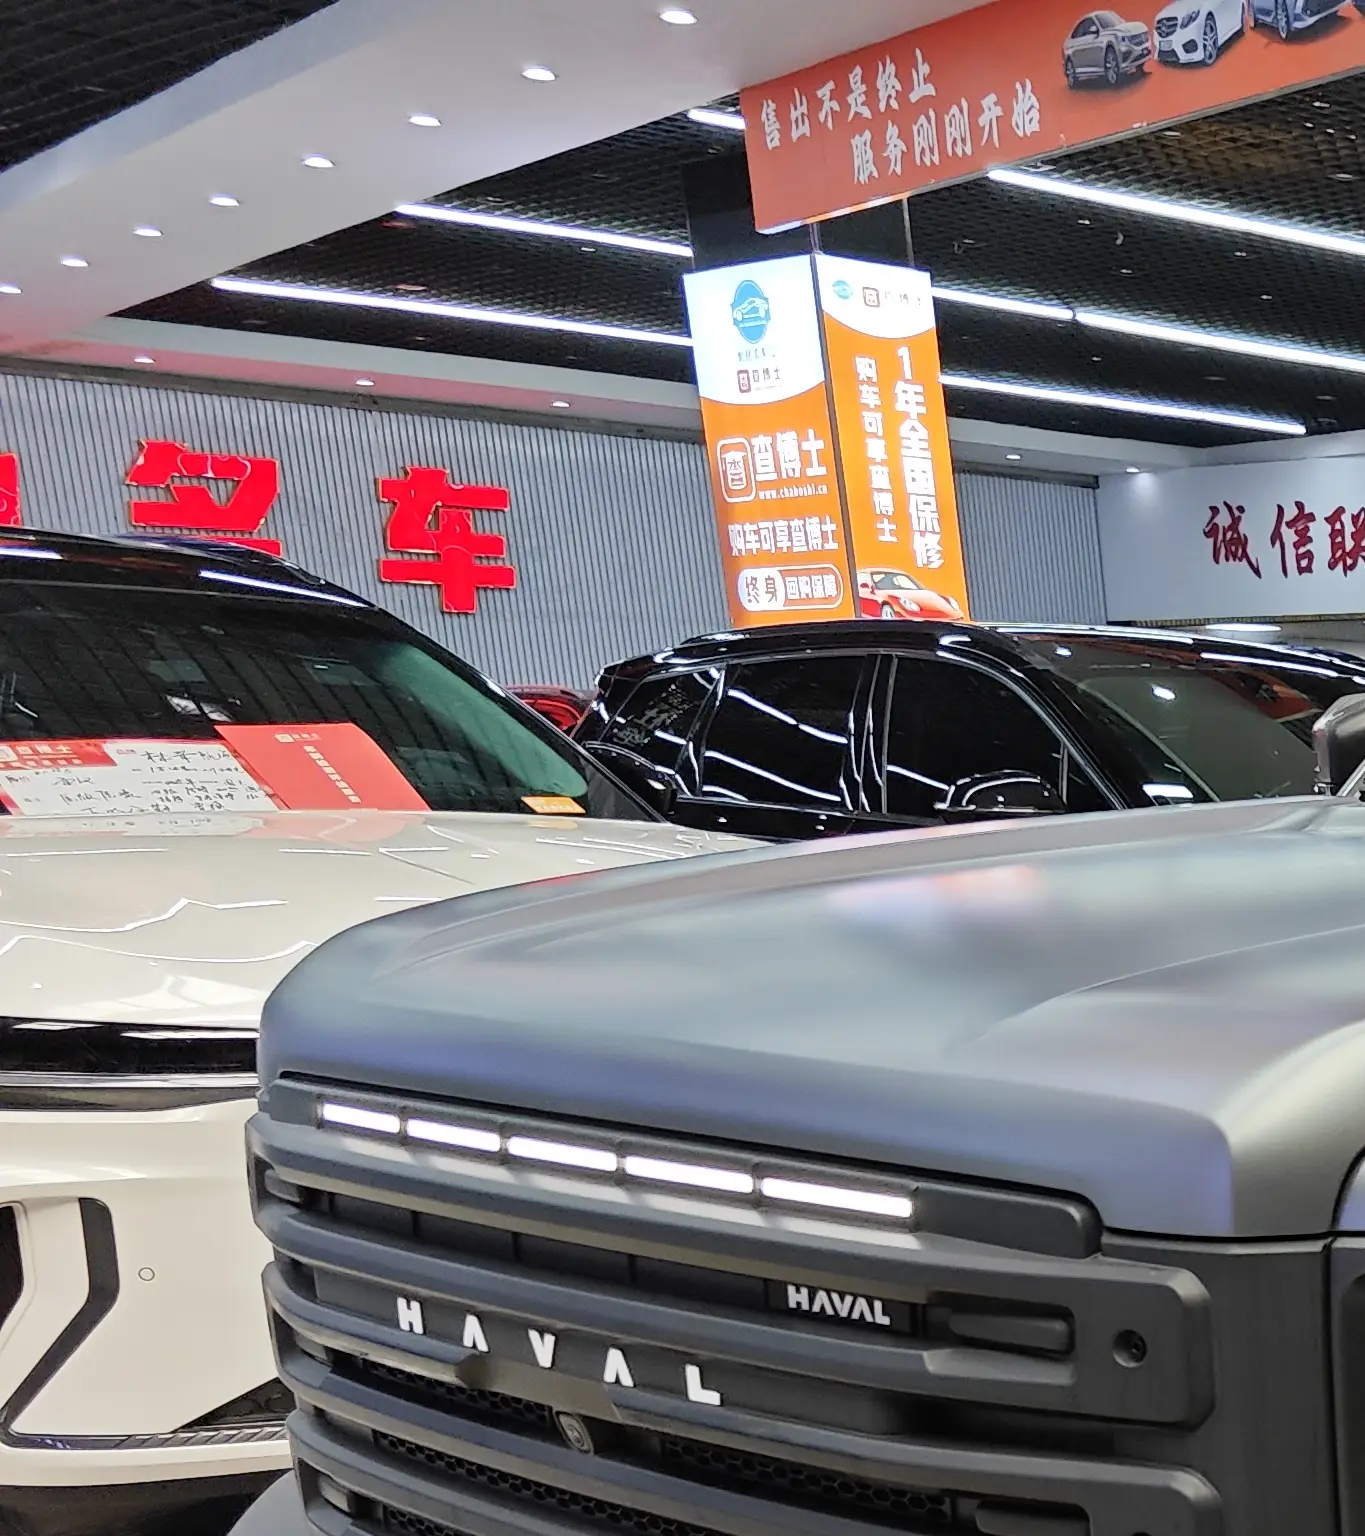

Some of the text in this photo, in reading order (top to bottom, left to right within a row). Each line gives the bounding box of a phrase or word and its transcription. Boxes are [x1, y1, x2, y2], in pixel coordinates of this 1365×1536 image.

[761, 48, 935, 149] 售出不是终止
[853, 80, 1041, 184] 服务刚刚开始
[752, 429, 828, 482] 查博士
[855, 356, 899, 543] 购车可享查博士
[893, 346, 944, 568] 1年全国保修
[728, 516, 840, 557] 购车可享查博士
[745, 575, 778, 603] 终身
[785, 574, 837, 600] 回购保障
[787, 1282, 892, 1327] HAVAL
[396, 1295, 722, 1406] HAVAL
